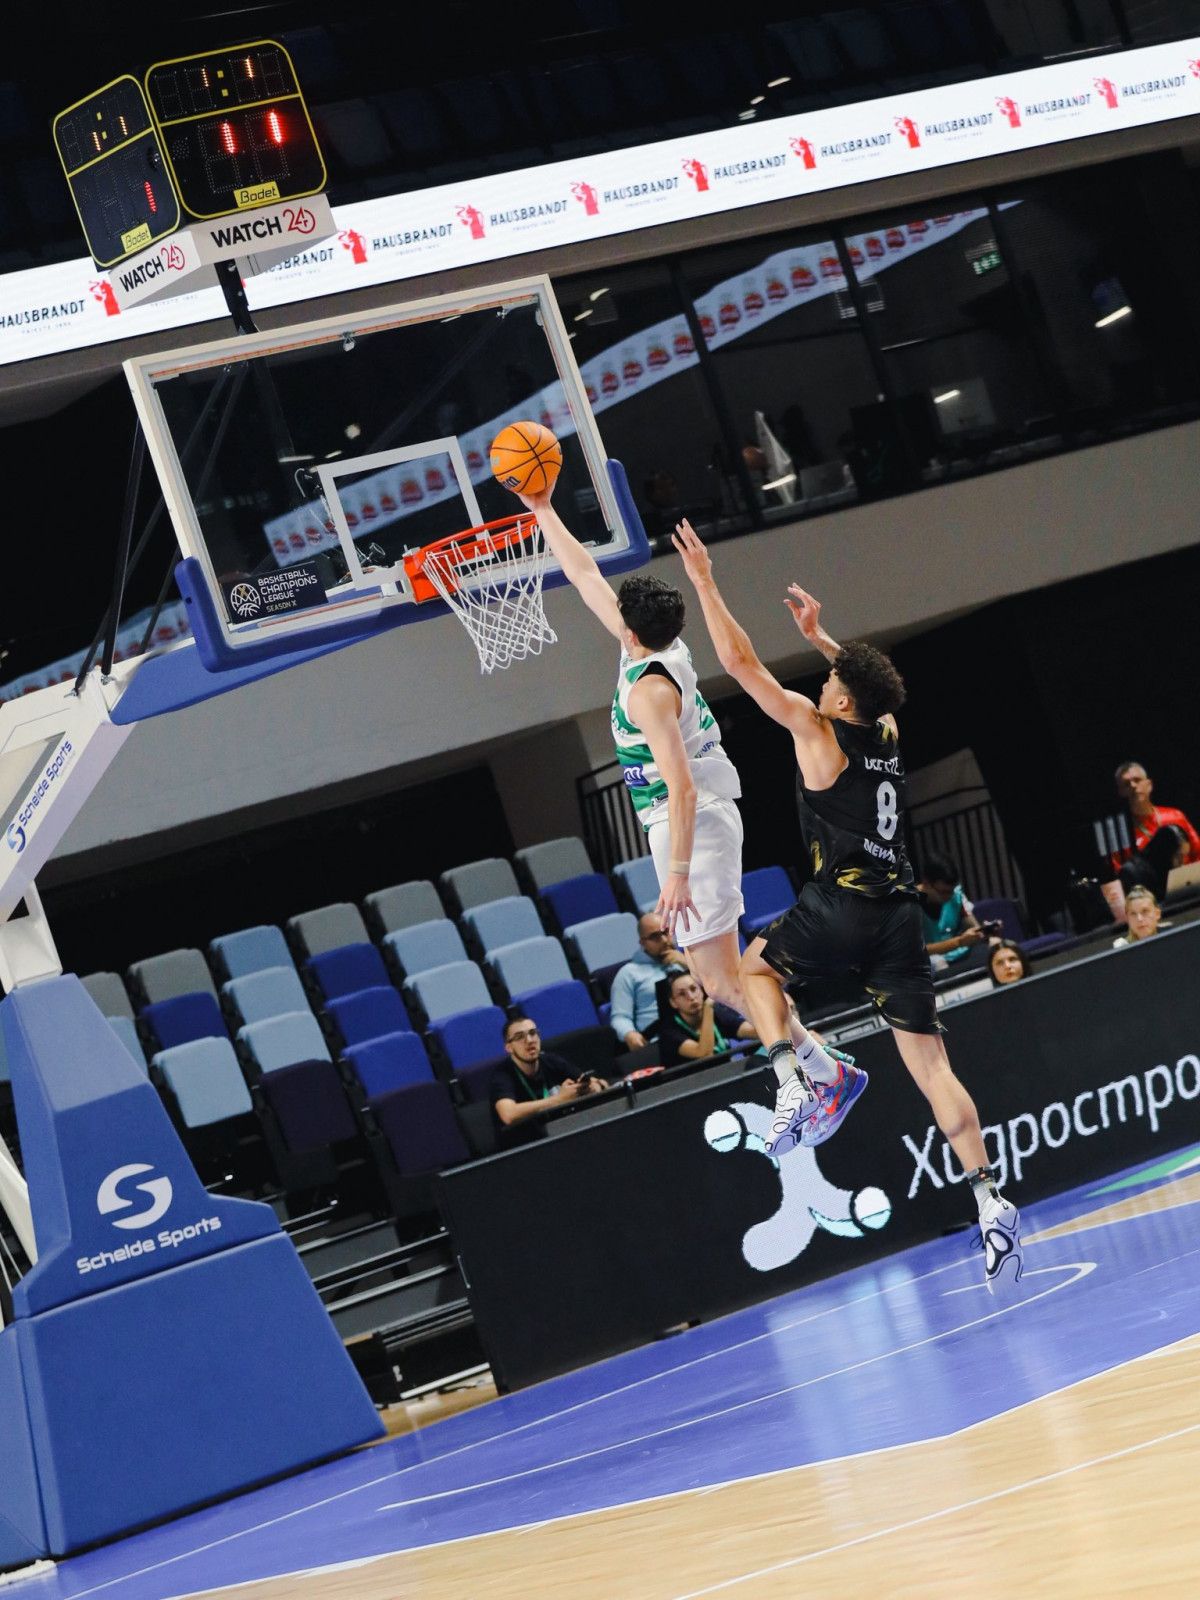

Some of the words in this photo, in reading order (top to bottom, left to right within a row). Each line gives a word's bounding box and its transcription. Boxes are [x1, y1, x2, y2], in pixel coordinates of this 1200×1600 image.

[1123, 73, 1187, 97] HAUSBRANDT
[1025, 93, 1091, 116] HAUSBRANDT
[924, 113, 993, 136] HAUSBRANDT
[820, 133, 892, 157] HAUSBRANDT
[713, 153, 787, 180] HAUSBRANDT
[240, 187, 277, 204] Bodet
[603, 177, 679, 203] HAUSBRANDT
[490, 200, 567, 226] HAUSBRANDT
[125, 230, 150, 249] Bodet
[210, 216, 283, 248] WATCH
[372, 223, 453, 251] HAUSBRANDT
[119, 255, 165, 292] WATCH
[258, 569, 309, 587] BASKETBALL
[260, 575, 318, 596] CHAMPIONS
[262, 590, 295, 604] LEAGUE
[265, 601, 292, 613] SEASON
[46, 740, 73, 781] Sports
[876, 780, 899, 841] 8
[76, 1239, 156, 1275] Schelde
[157, 1216, 222, 1248] Sports
